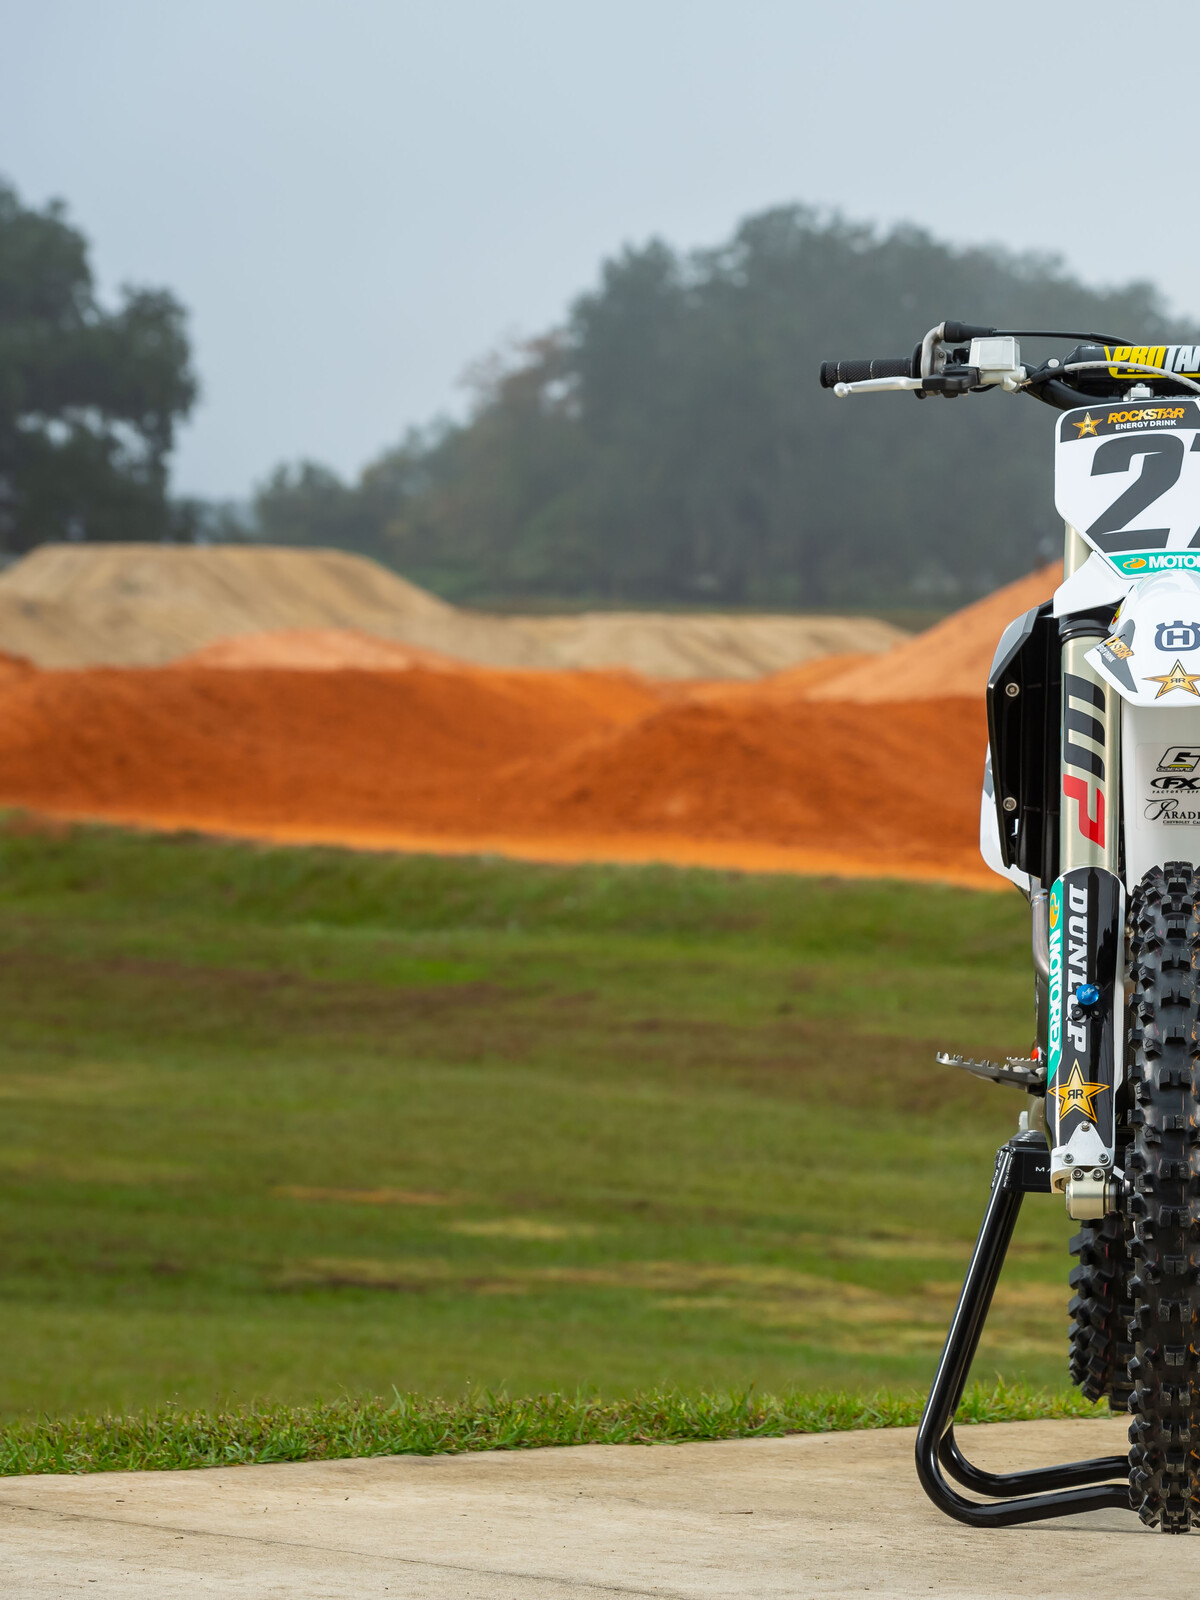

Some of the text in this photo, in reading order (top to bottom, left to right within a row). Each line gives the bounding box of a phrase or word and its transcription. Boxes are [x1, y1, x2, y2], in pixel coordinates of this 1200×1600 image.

[1107, 407, 1185, 425] ROCKSTAR
[1115, 419, 1177, 431] ENERGY DRINK
[1049, 928, 1063, 1060] MOTOREX
